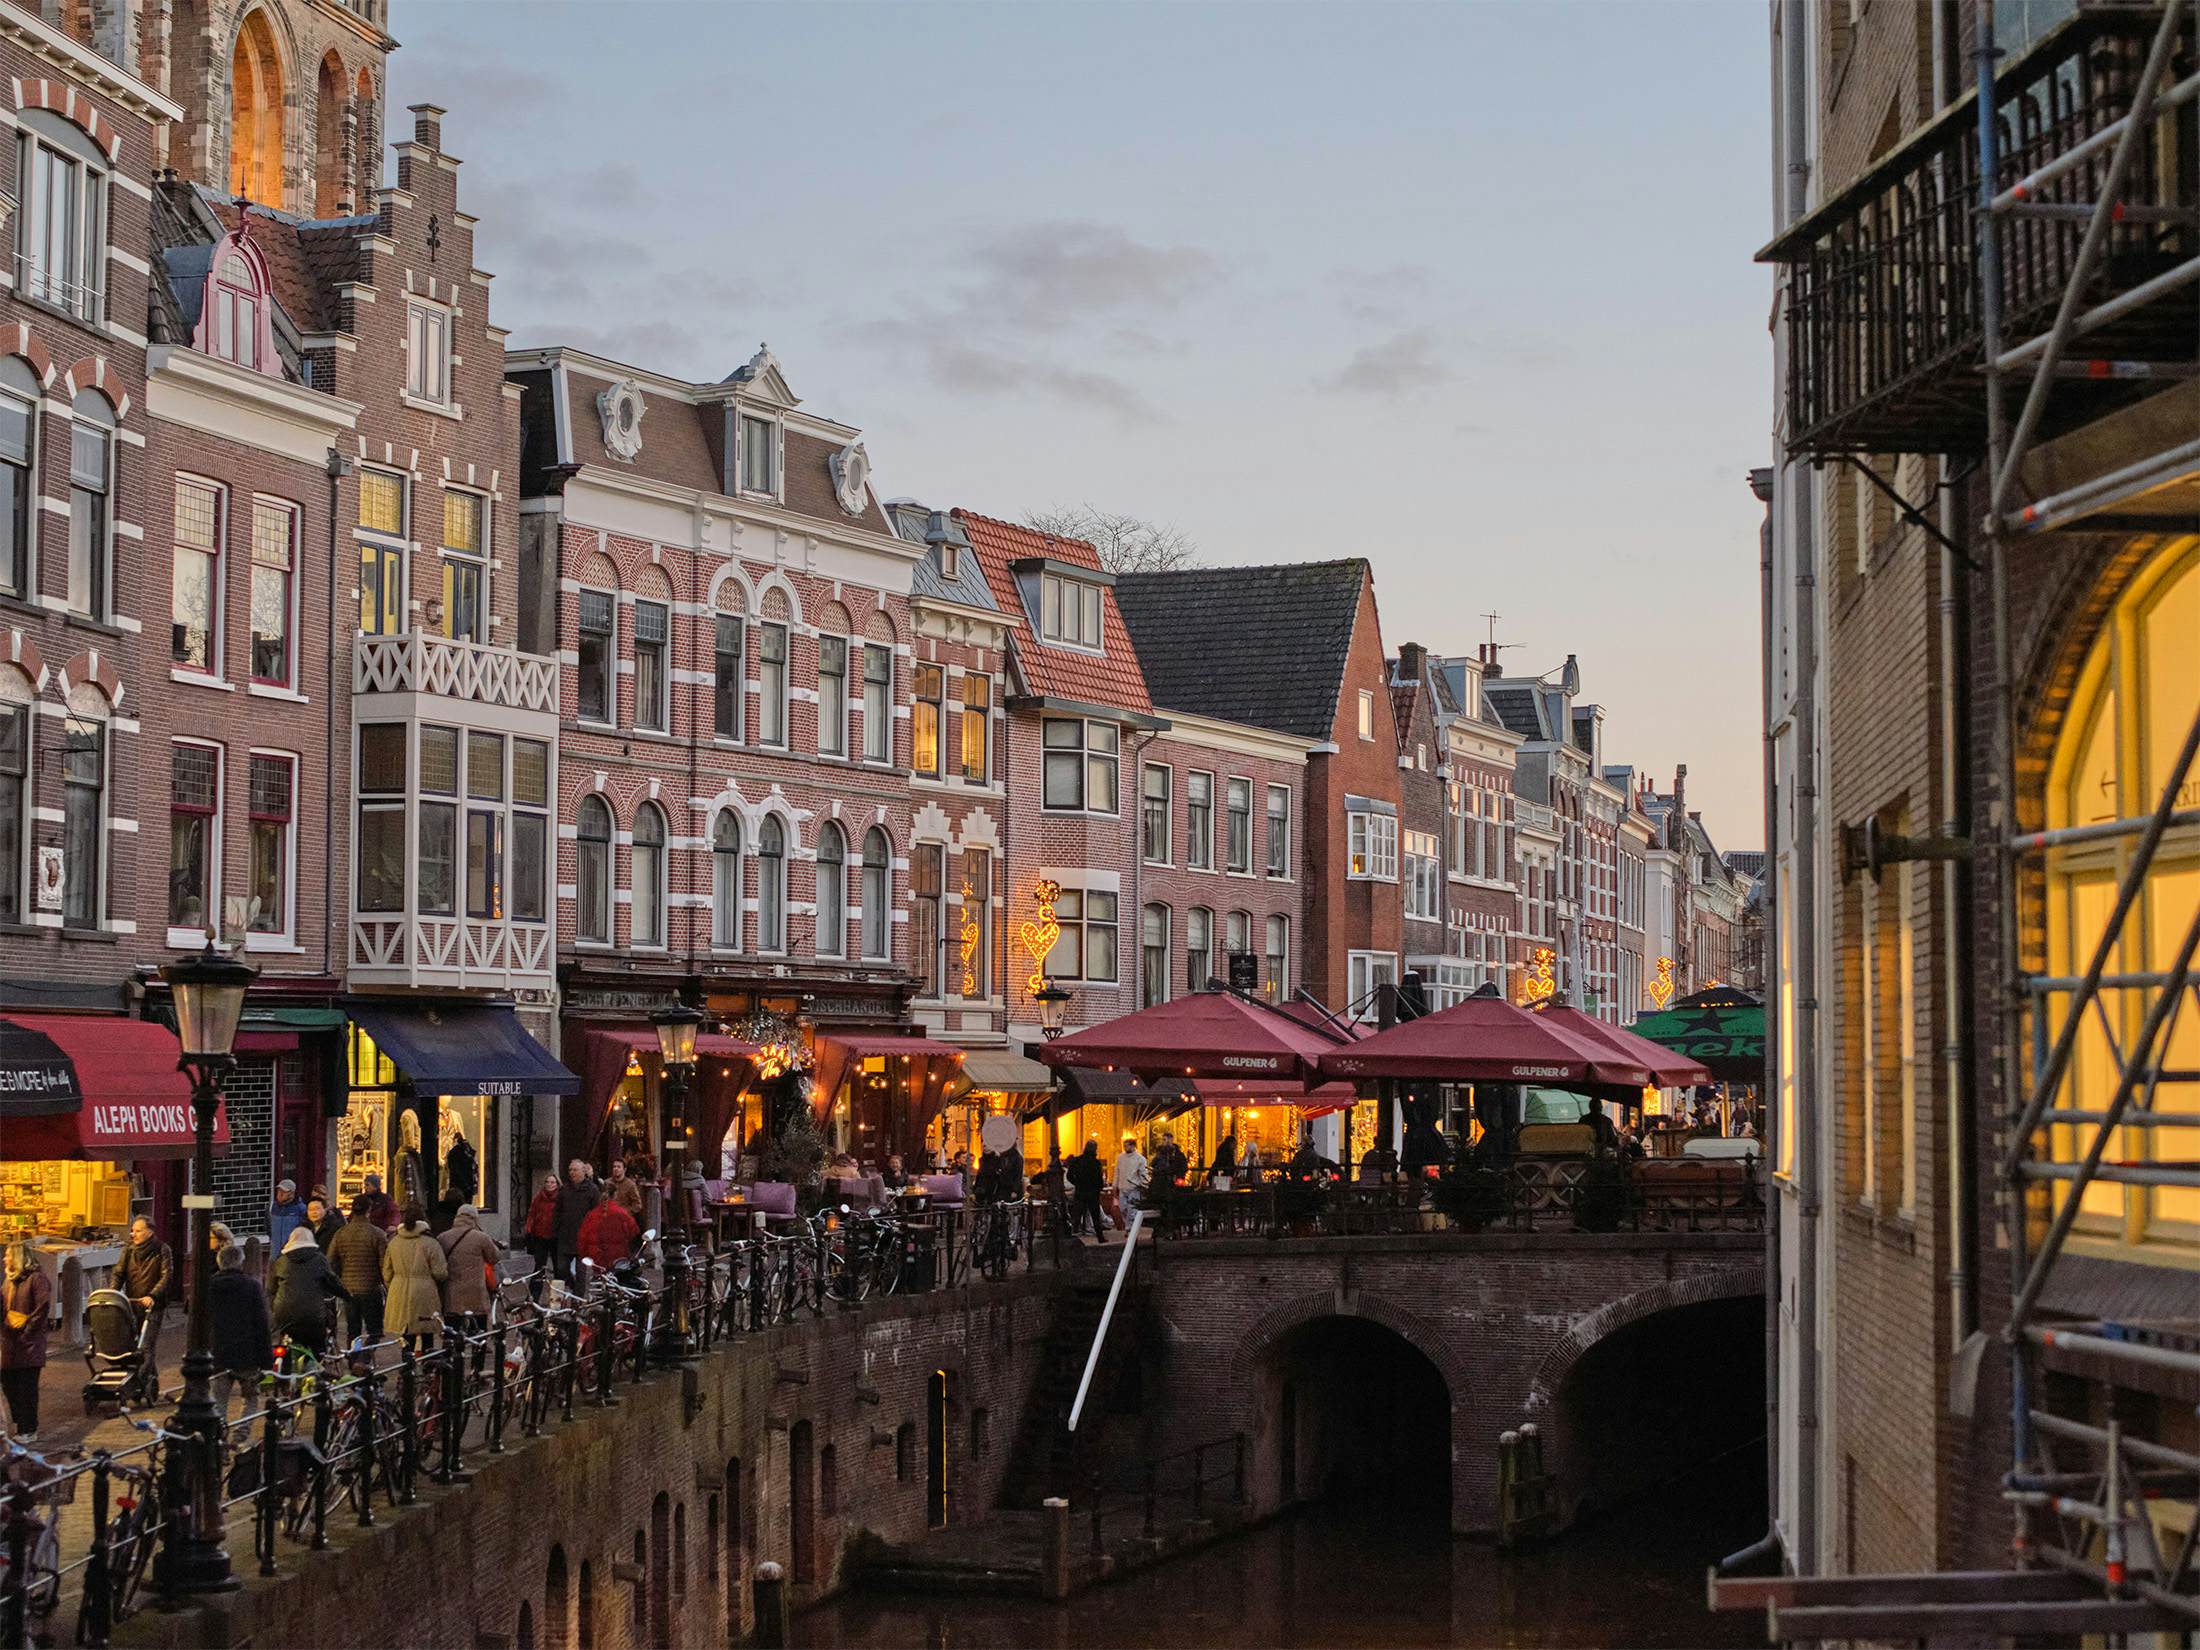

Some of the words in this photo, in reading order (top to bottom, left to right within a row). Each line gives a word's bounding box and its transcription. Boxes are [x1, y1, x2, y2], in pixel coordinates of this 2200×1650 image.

[1223, 1056, 1267, 1068] GULPENER
[1512, 1065, 1559, 1077] GULPENER
[478, 1082, 521, 1095] SUITABLE
[94, 1105, 138, 1133] ALEPH
[139, 1105, 186, 1133] BOOKS
